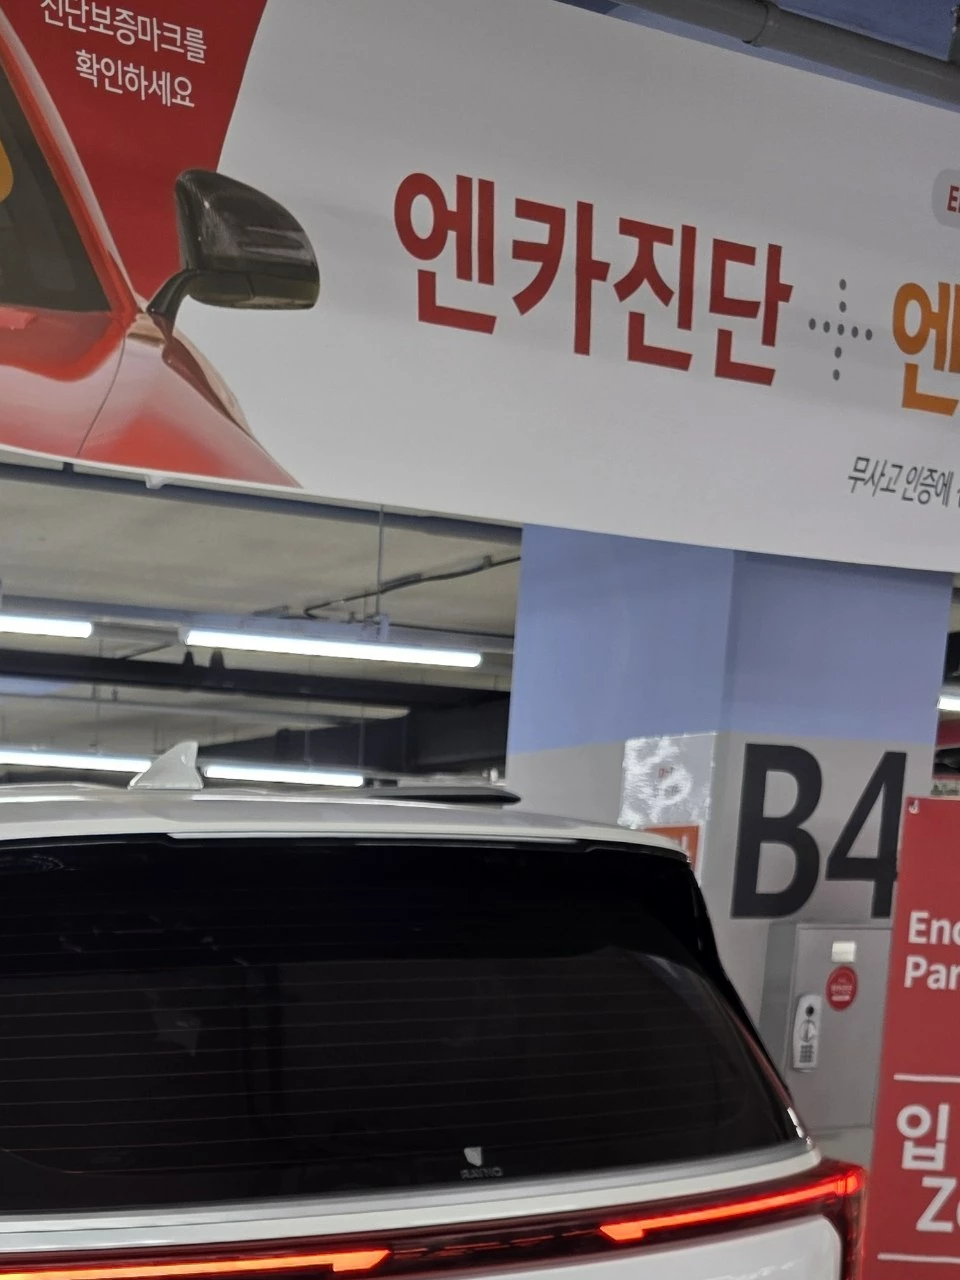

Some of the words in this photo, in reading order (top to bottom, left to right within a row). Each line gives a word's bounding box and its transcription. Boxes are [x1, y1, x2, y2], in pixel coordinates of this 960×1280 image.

[40, 0, 207, 64] 진단보증마크를
[75, 49, 195, 108] 확인하세요
[394, 172, 794, 387] 엔카진단
[848, 456, 903, 497] 무사고
[902, 466, 954, 507] 인증에
[730, 743, 907, 919] B4
[896, 1103, 950, 1171] 입
[915, 1176, 960, 1233] Z
